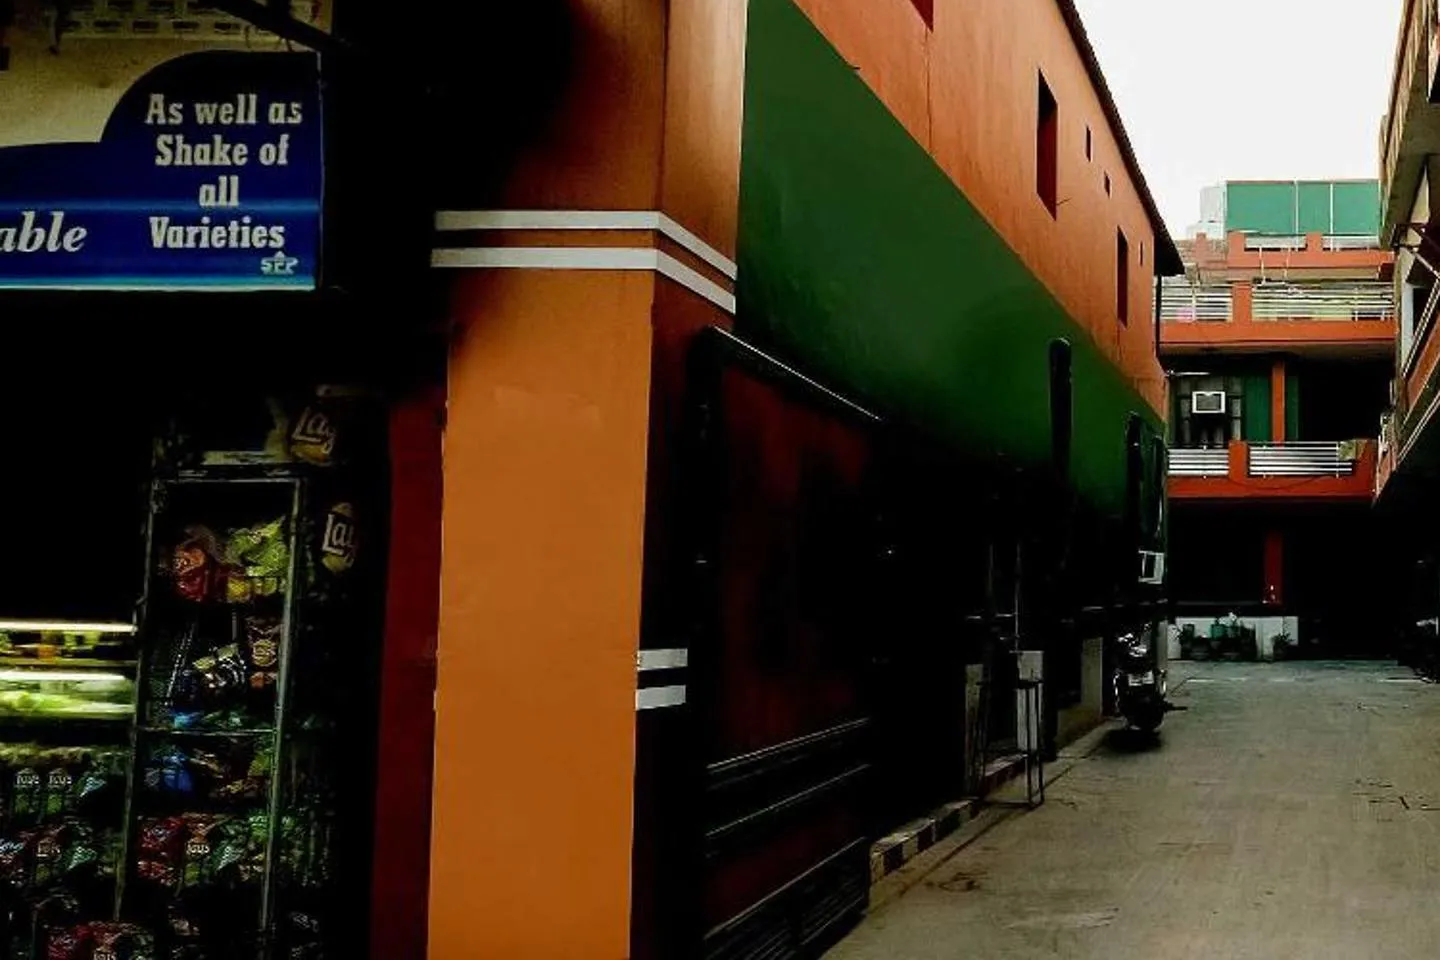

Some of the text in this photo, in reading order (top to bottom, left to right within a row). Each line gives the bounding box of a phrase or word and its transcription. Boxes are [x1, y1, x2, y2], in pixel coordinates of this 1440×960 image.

[145, 94, 303, 124] As well as
[155, 134, 289, 166] Shake of
[199, 175, 239, 207] all
[0, 211, 87, 252] able
[149, 216, 285, 249] Varieties
